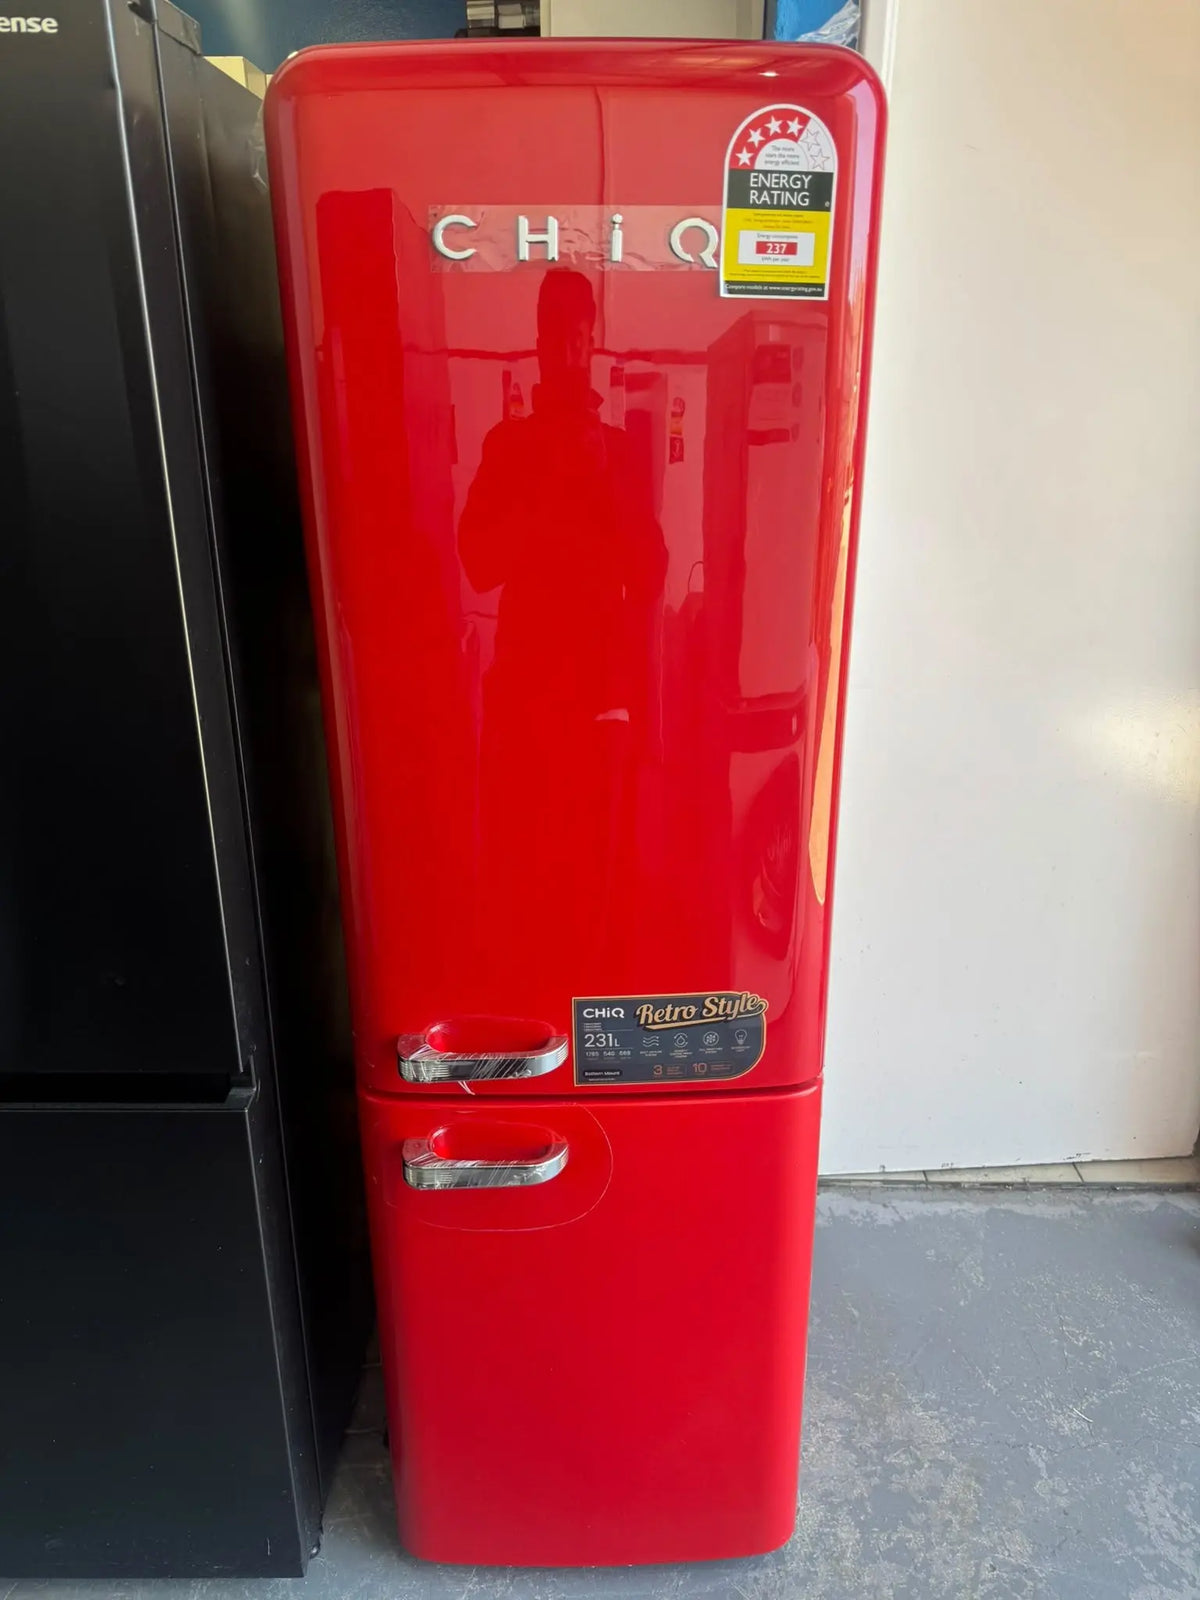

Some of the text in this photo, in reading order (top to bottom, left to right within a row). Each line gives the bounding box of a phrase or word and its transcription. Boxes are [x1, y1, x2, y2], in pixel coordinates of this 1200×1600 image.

[750, 173, 812, 189] ENERGY
[750, 190, 810, 206] RATING
[766, 243, 788, 254] 237
[583, 1007, 625, 1019] CHiQ
[635, 993, 767, 1026] Retro Style
[653, 1064, 663, 1075] 3
[692, 1062, 708, 1074] 10
